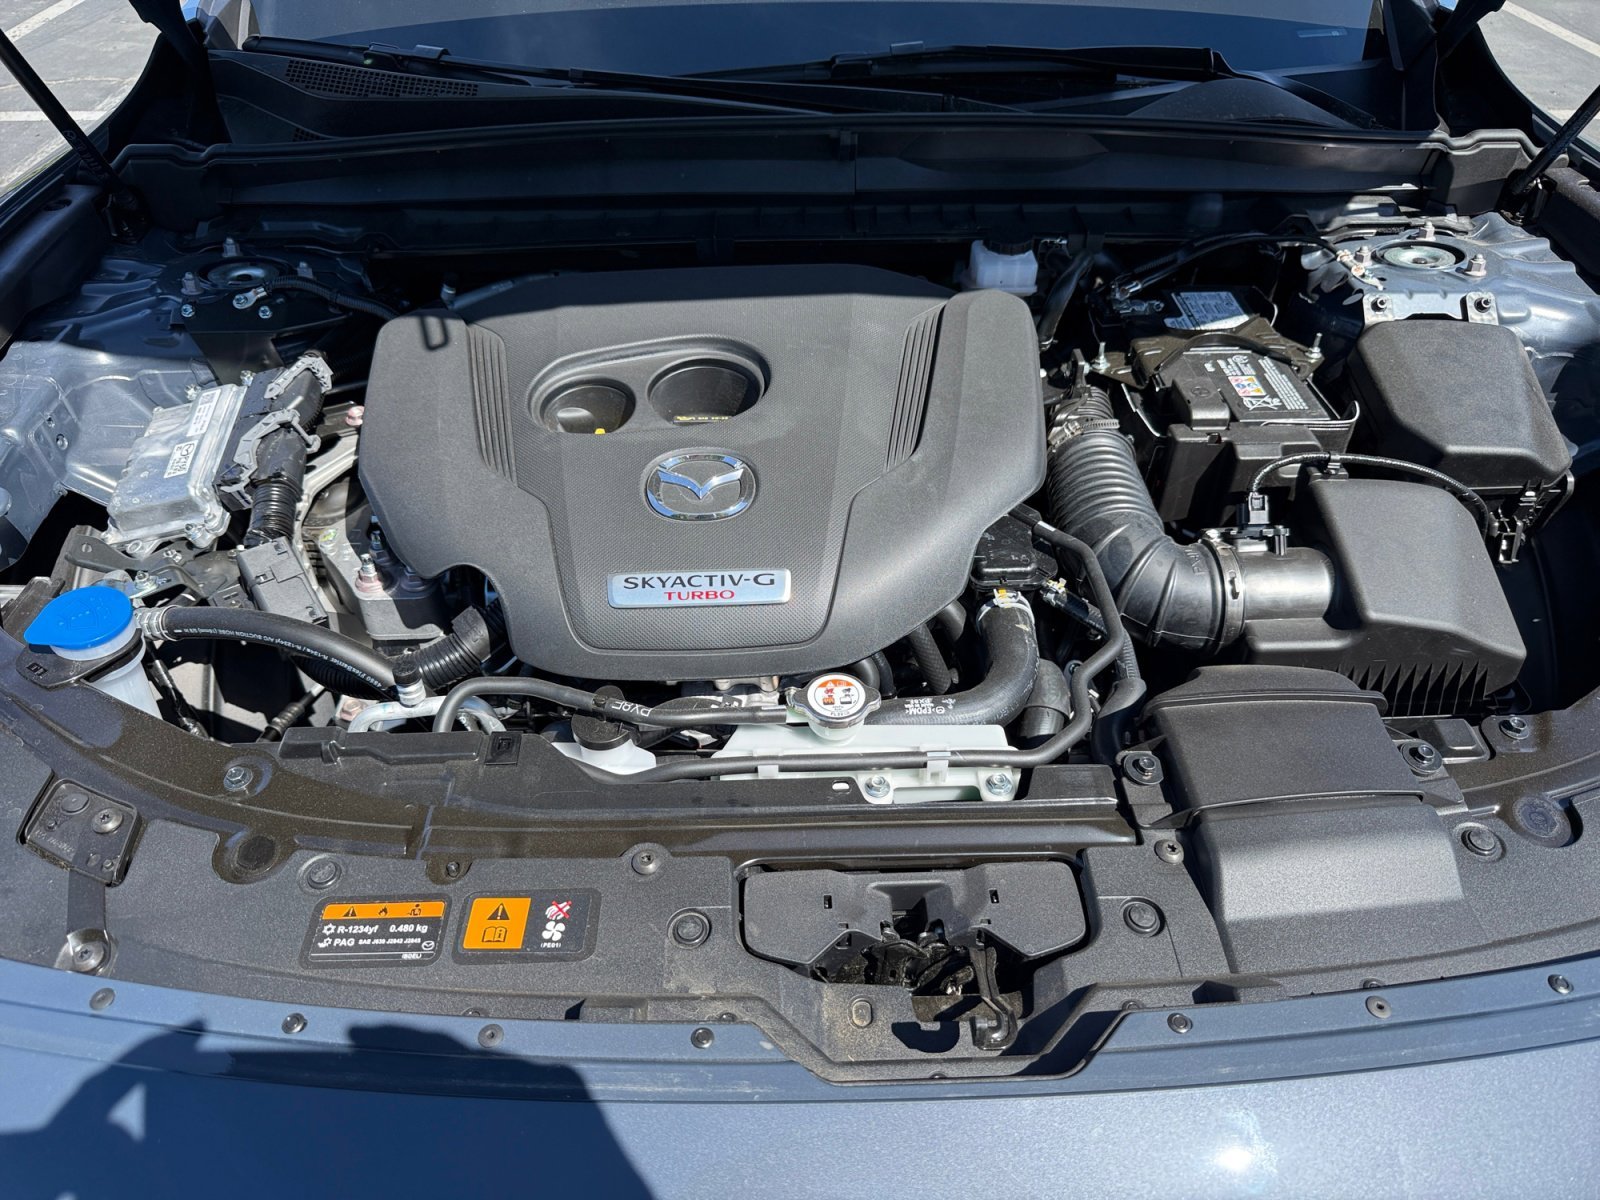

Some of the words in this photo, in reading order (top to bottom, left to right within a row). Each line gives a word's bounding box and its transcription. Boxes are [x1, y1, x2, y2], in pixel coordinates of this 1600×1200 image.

[623, 573, 775, 590] SKYACTIV-G
[664, 590, 735, 601] TURBO
[235, 631, 262, 640] SUCTION
[337, 924, 379, 935] R-1234yf
[389, 924, 414, 933] 0.480
[416, 924, 428, 934] kg
[333, 938, 355, 946] PAG
